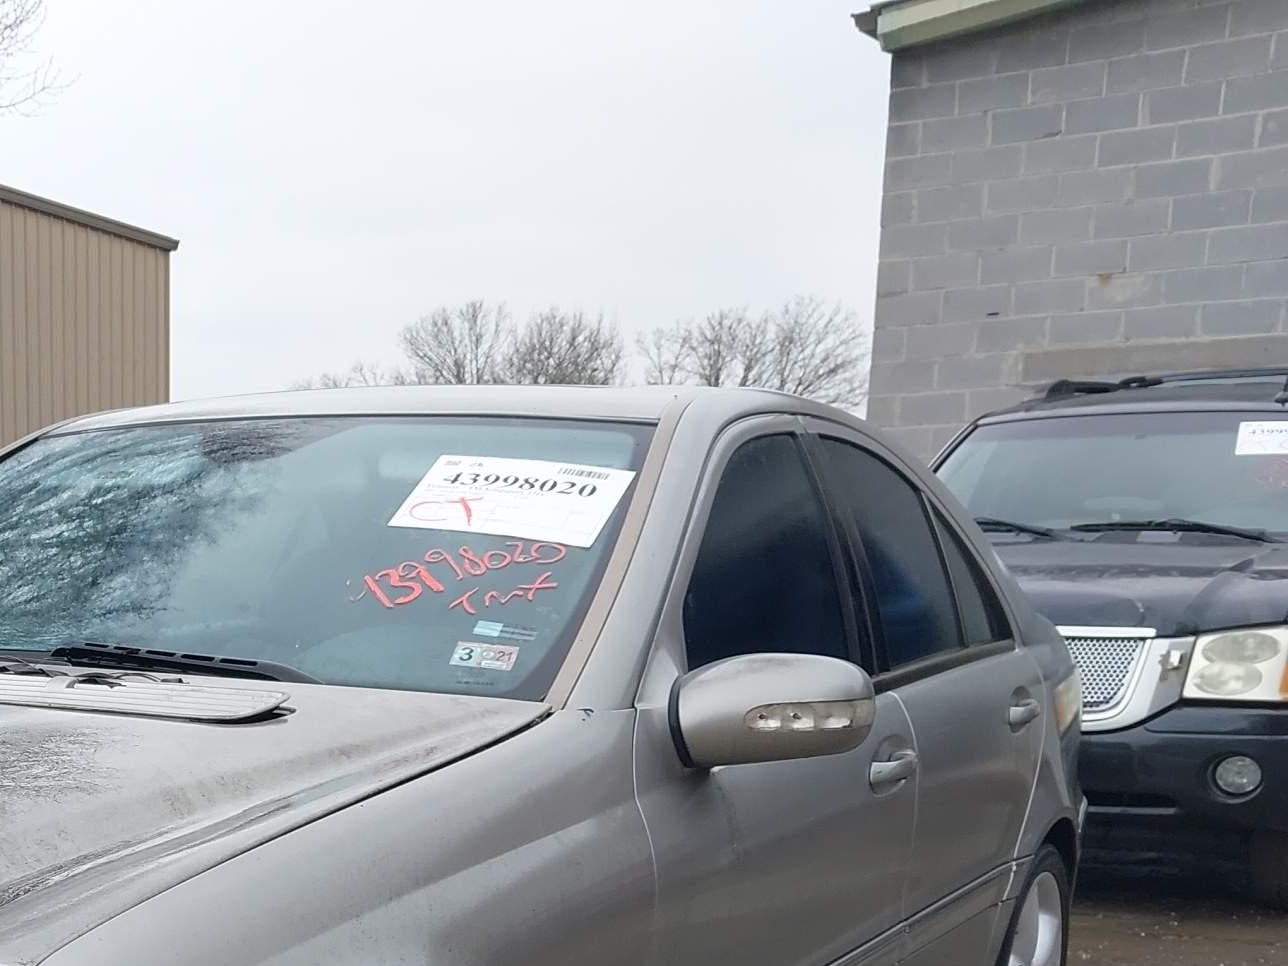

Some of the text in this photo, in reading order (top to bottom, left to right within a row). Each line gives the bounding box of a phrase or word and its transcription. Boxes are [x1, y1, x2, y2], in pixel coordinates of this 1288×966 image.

[443, 471, 598, 498] 43998020
[459, 647, 514, 663] 3 21
